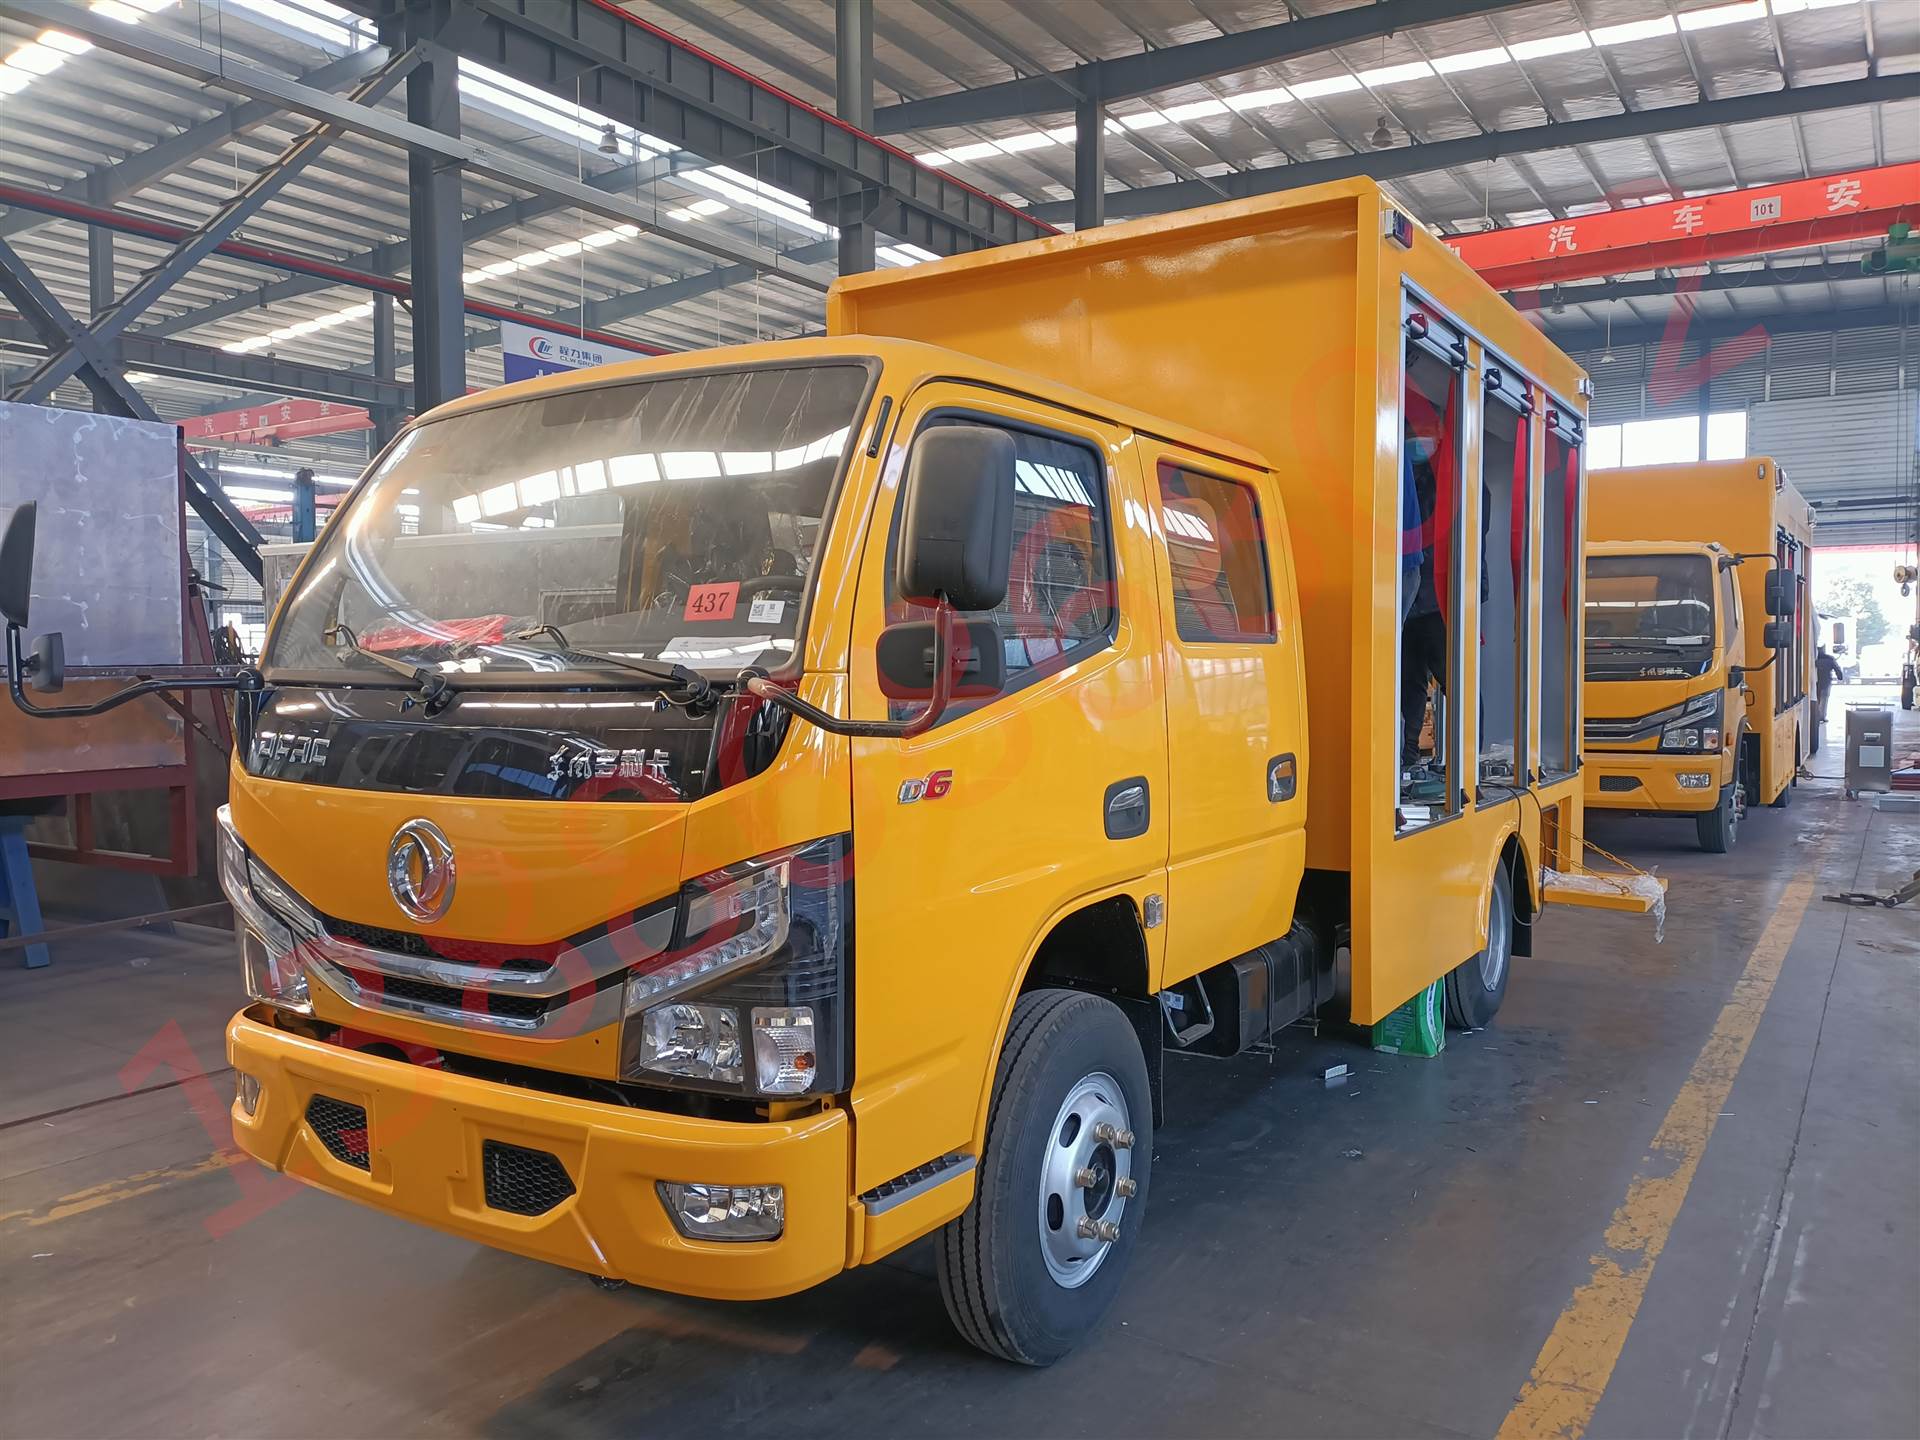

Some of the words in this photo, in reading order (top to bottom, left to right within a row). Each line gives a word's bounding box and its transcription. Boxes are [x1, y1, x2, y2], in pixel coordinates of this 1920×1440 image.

[1825, 178, 1862, 212] 安
[1753, 202, 1774, 217] 10t
[559, 344, 603, 364] 程力集团
[577, 359, 602, 368] GRO
[691, 591, 731, 614] 437
[897, 769, 953, 805] D6
